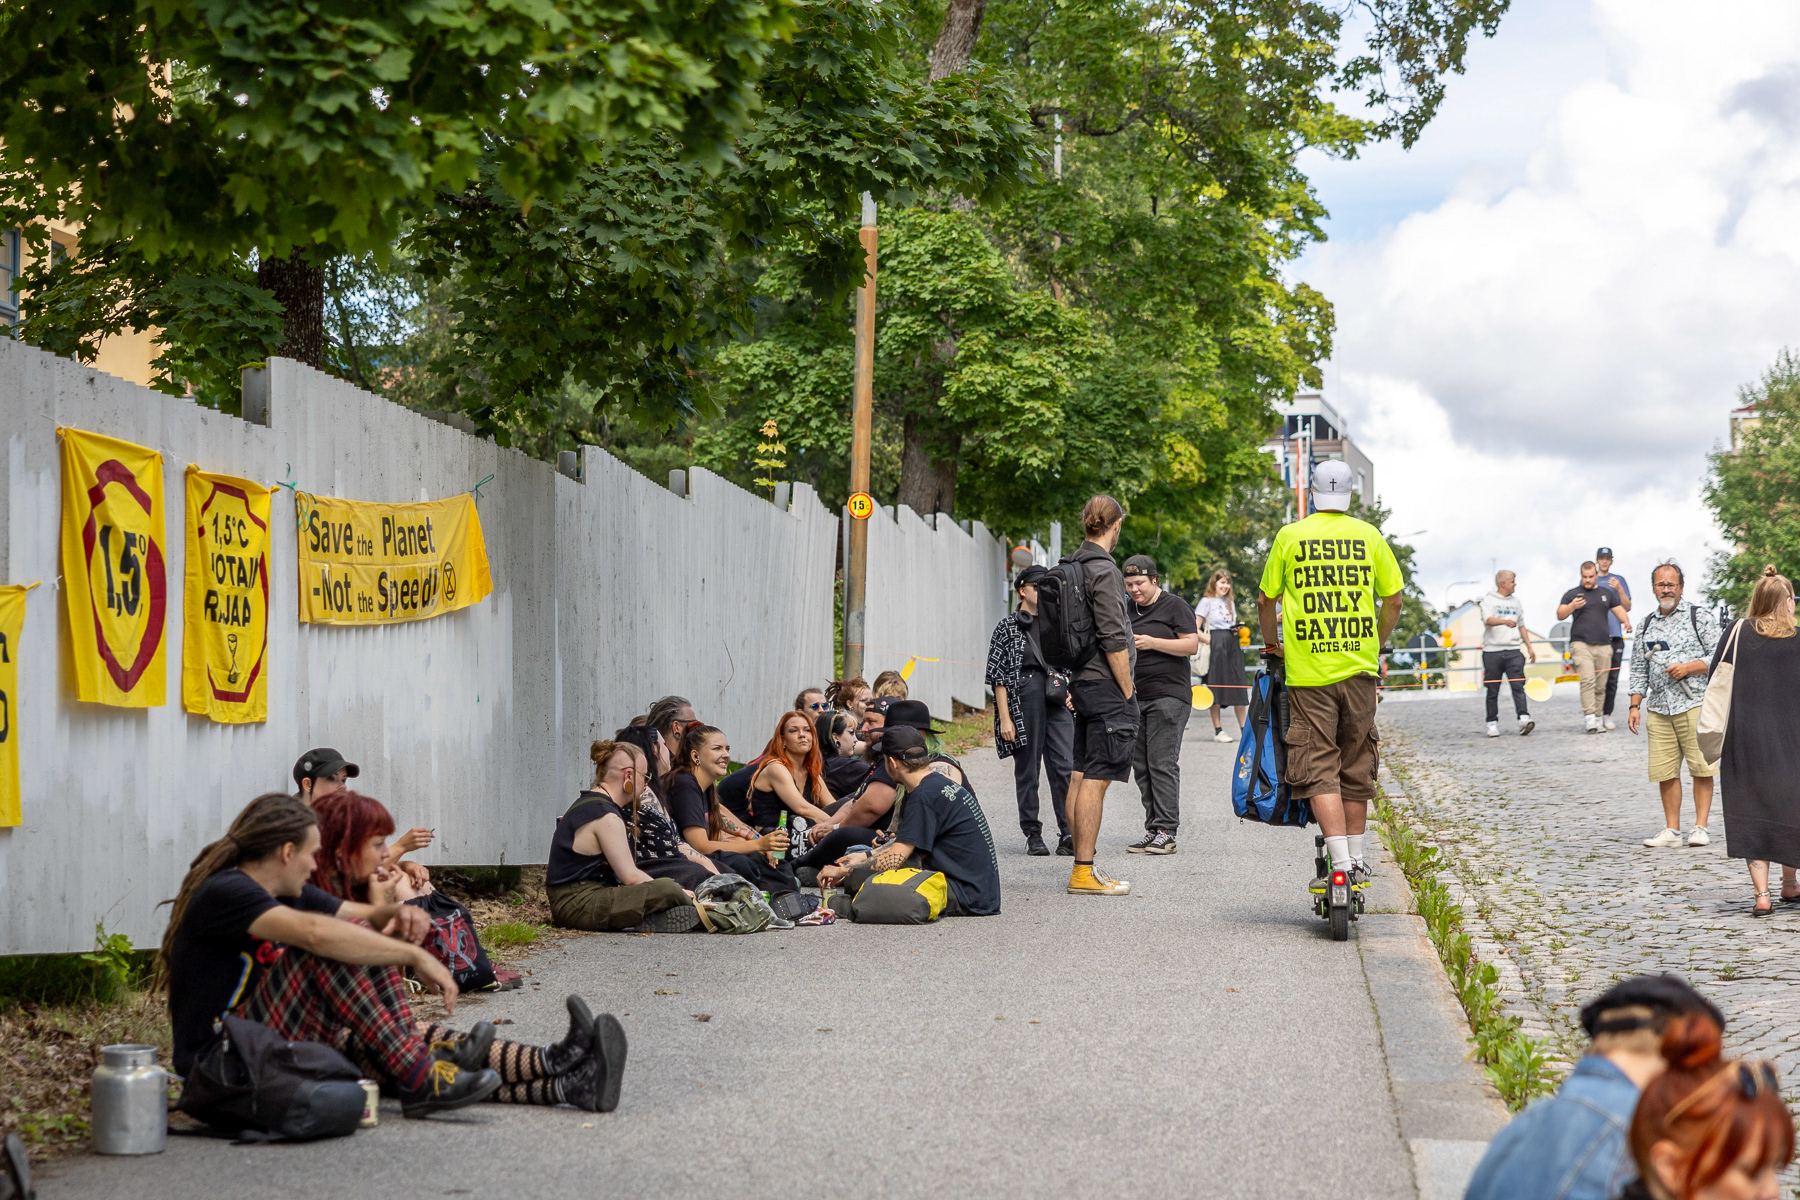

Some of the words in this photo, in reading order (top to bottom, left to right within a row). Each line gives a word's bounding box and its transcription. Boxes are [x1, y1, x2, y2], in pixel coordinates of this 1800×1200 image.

[309, 509, 353, 556] Save
[357, 533, 373, 556] the
[382, 514, 435, 557] Planet
[1294, 539, 1366, 563] JESUS
[1293, 564, 1371, 589] CHRIST
[357, 590, 374, 613] the
[377, 567, 438, 618] Speed!
[1303, 590, 1362, 614] ONLY
[1294, 616, 1374, 641] SAVIOR
